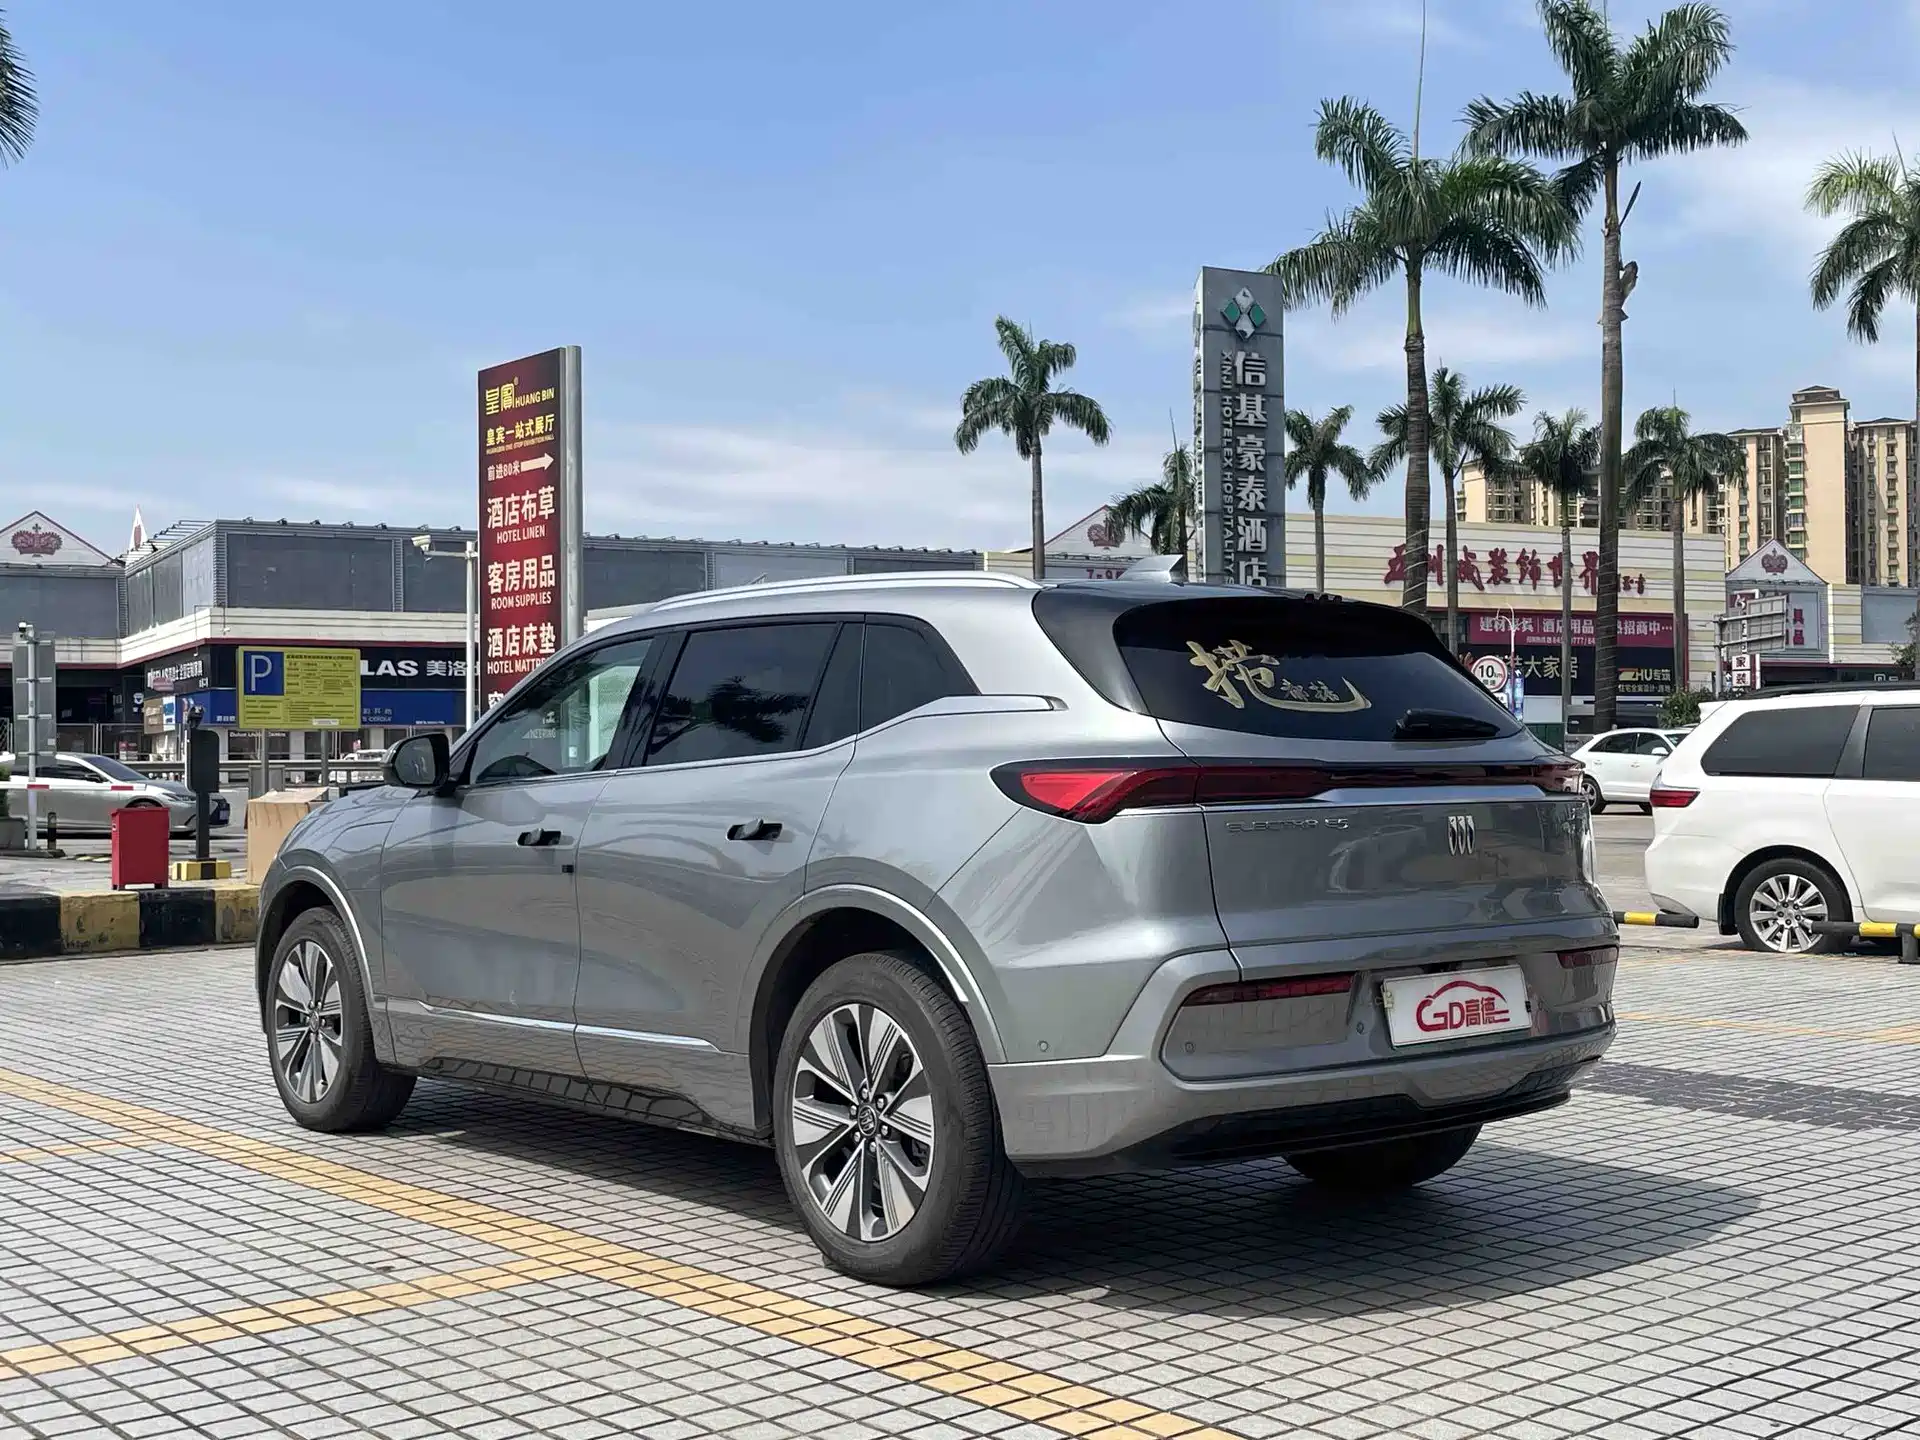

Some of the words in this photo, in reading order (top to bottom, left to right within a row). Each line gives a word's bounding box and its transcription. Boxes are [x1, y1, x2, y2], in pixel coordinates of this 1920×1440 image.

[1221, 350, 1233, 390] XINJI
[515, 391, 540, 408] HUANG
[541, 387, 555, 402] BIN
[486, 413, 555, 447] 皇宾一站式展厅
[1222, 396, 1235, 467] HOTELEX
[487, 460, 520, 482] 前进80米
[1235, 350, 1267, 586] 信基豪泰酒店
[487, 485, 555, 529] 酒店布草
[1223, 472, 1235, 572] HOSPITALITY
[496, 529, 521, 544] HOTEL
[522, 525, 545, 540] LINEN
[488, 554, 556, 594] 客房用品
[491, 597, 514, 610] ROOM
[515, 591, 552, 608] SUPPLIES
[487, 622, 556, 658] 酒店床垫
[251, 655, 272, 691] P
[487, 661, 513, 674] HOTEL
